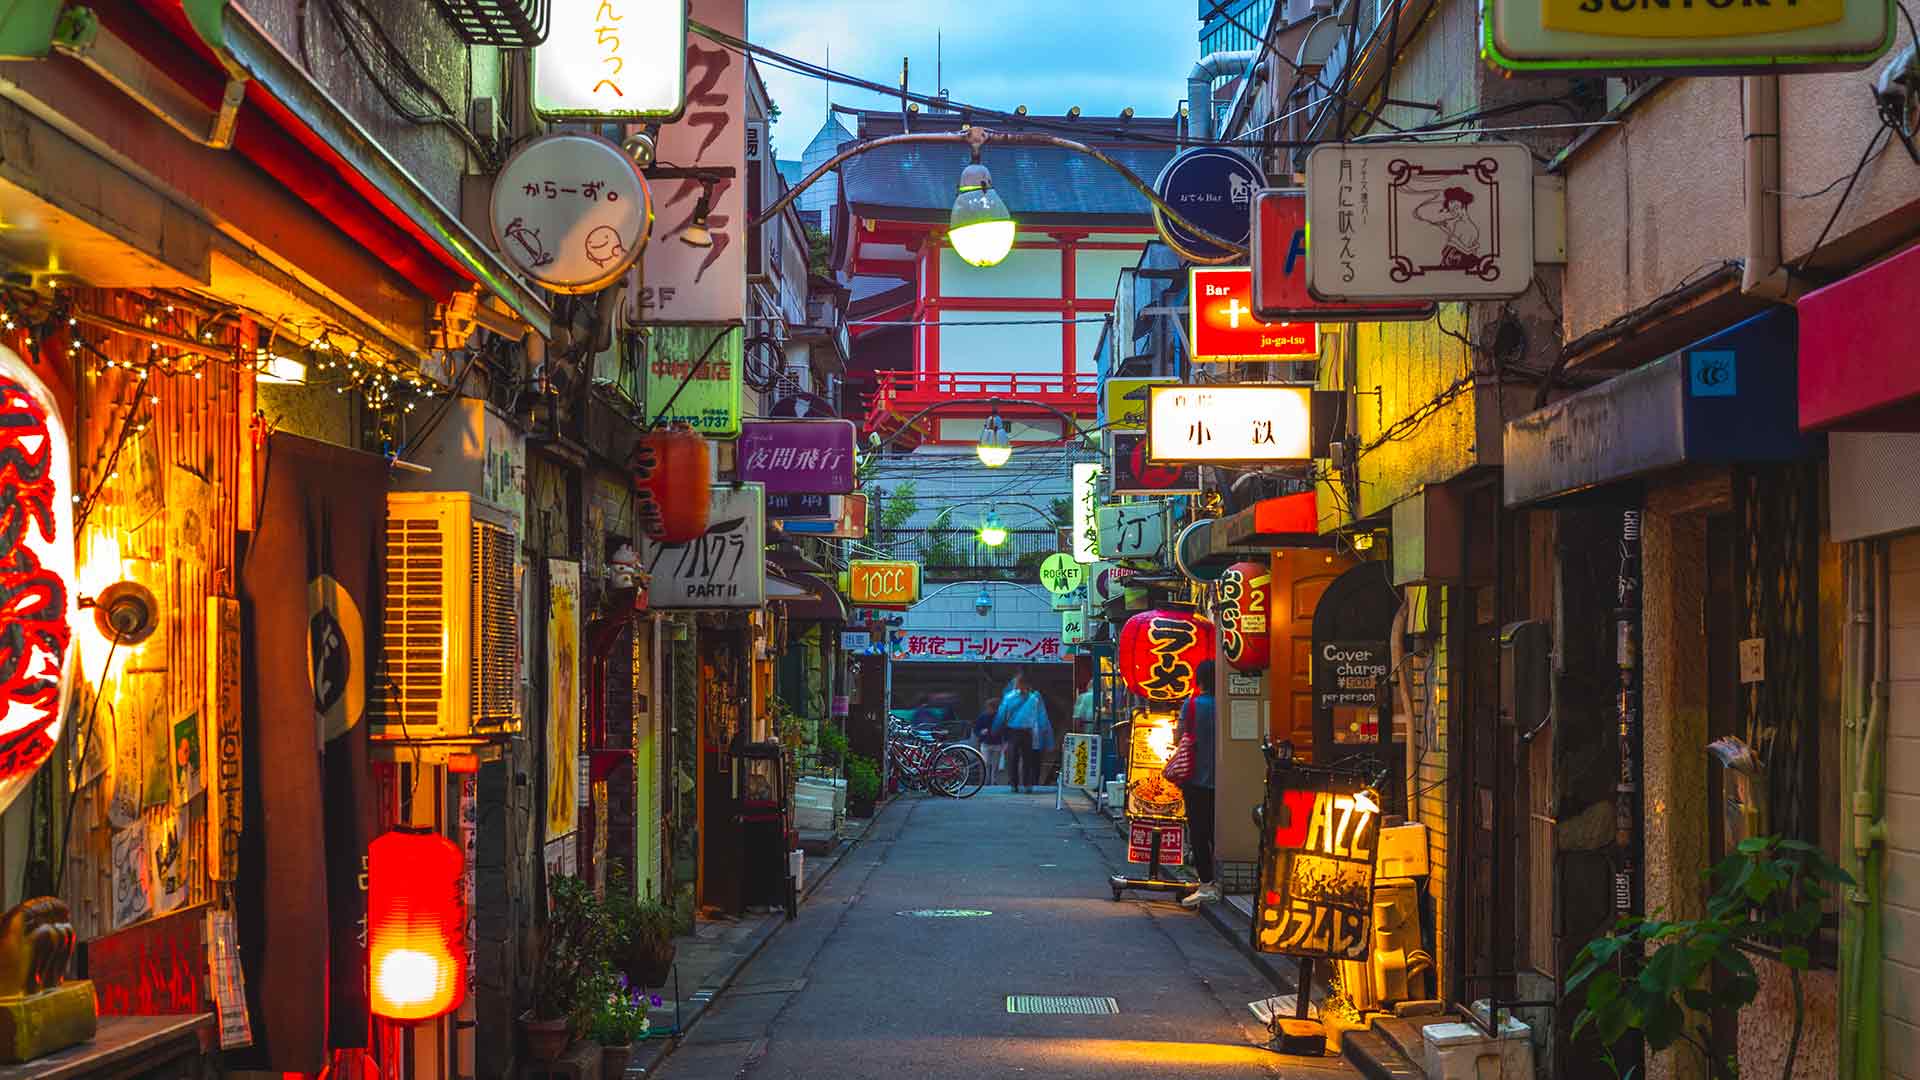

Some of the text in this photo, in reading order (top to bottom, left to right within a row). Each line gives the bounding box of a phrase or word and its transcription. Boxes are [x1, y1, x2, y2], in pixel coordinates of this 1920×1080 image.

[1338, 159, 1355, 283] 月に吠える
[637, 287, 677, 309] 2F
[1205, 283, 1231, 297] Bar
[1260, 335, 1305, 348] ju-ga-tsu
[745, 446, 847, 471] 夜間飛行
[1043, 568, 1079, 578] ROCKET
[687, 583, 726, 599] PART
[907, 635, 1060, 657] 新宿ゴールデン街
[1323, 644, 1373, 661] Cover
[1336, 663, 1386, 678] charge
[1321, 692, 1376, 703] per person
[1275, 790, 1380, 861] JAZZ
